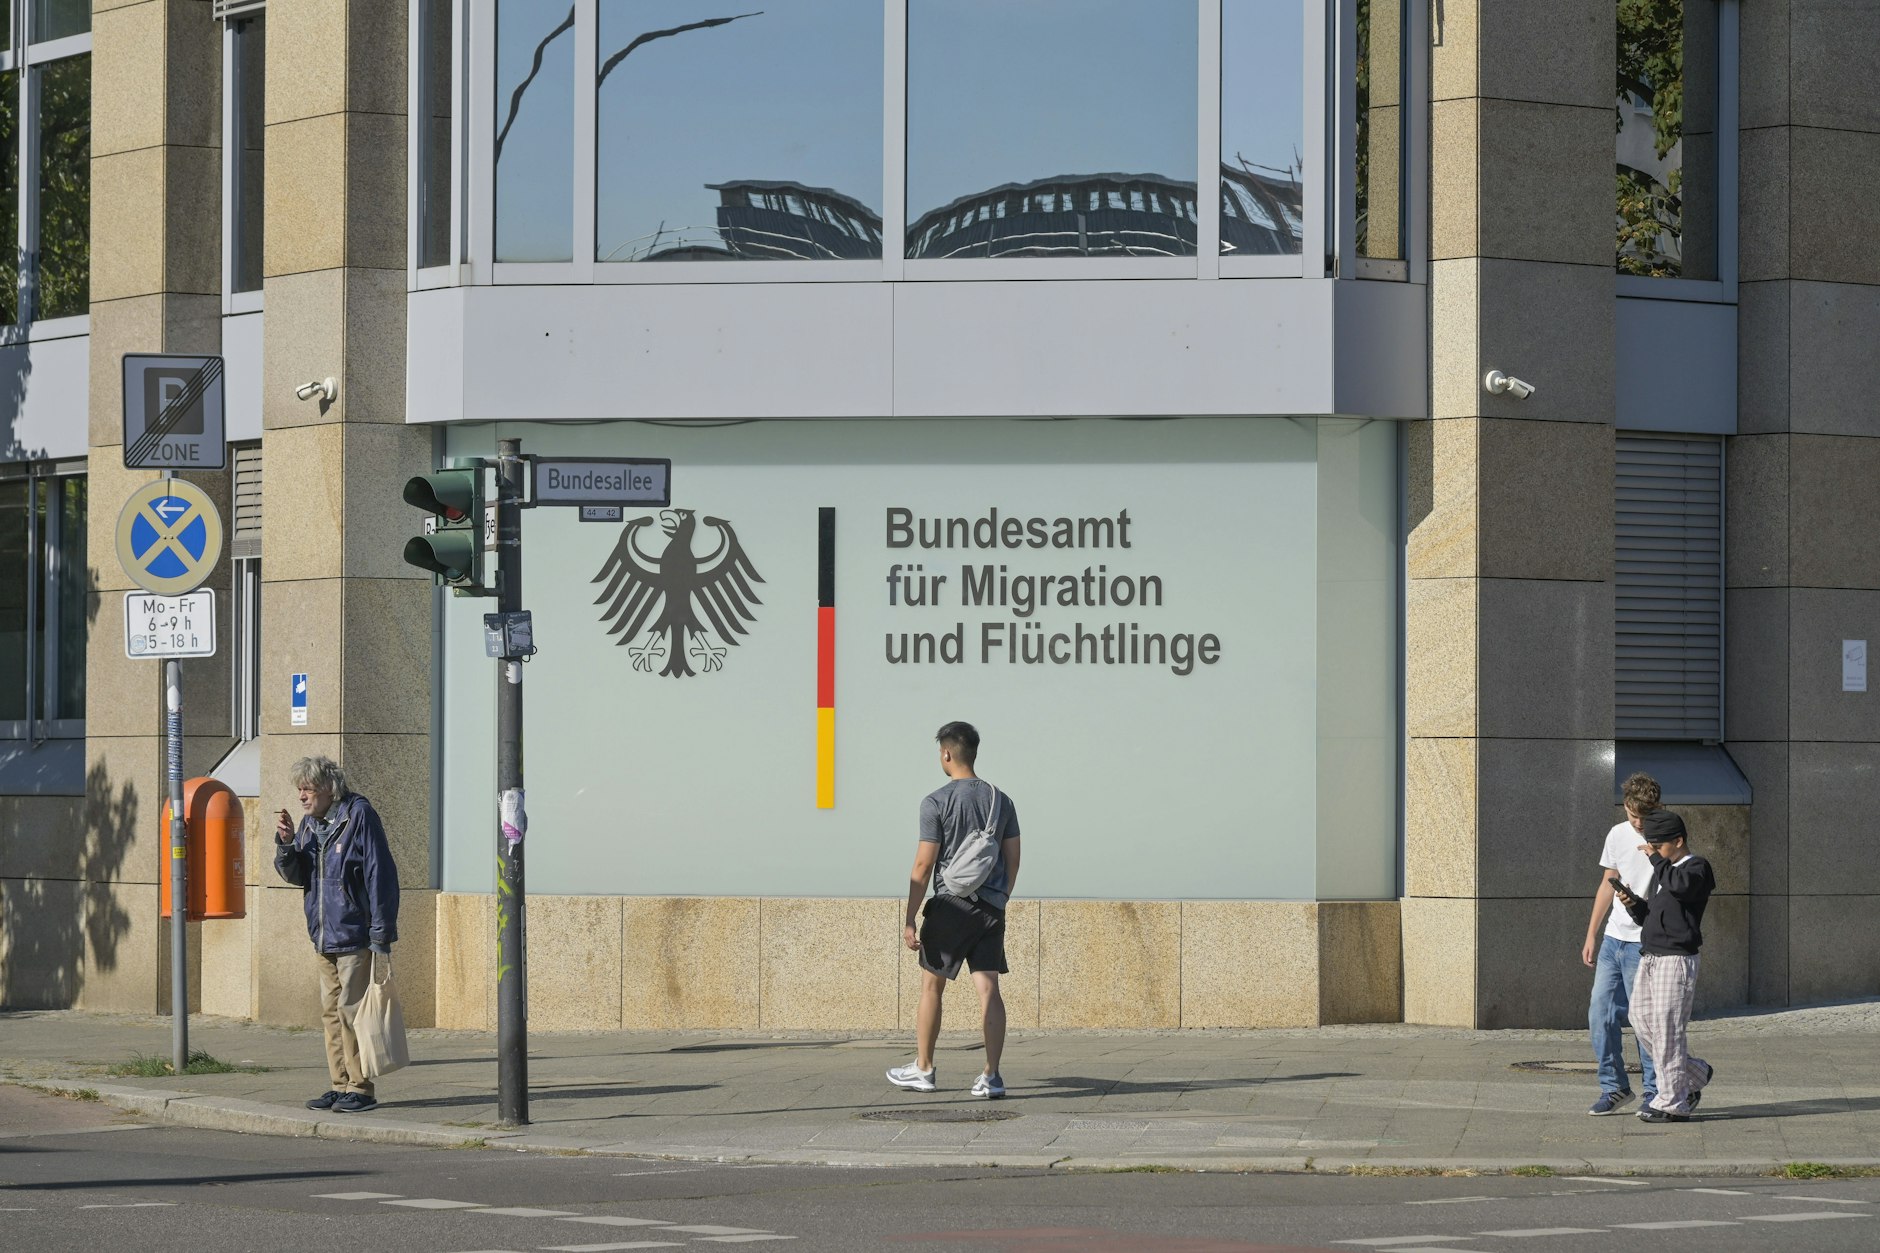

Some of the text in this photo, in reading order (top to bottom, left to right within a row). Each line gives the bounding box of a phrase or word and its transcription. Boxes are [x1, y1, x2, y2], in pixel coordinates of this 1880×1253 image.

[150, 443, 200, 461] ZONE
[549, 468, 652, 491] Bundesallee
[587, 508, 616, 517] 44 42
[886, 507, 1132, 549] Bundesamt
[886, 564, 1163, 618] für Migration
[185, 615, 191, 630] h
[191, 633, 198, 648] h
[885, 621, 1221, 676] und Flüchtlinge
